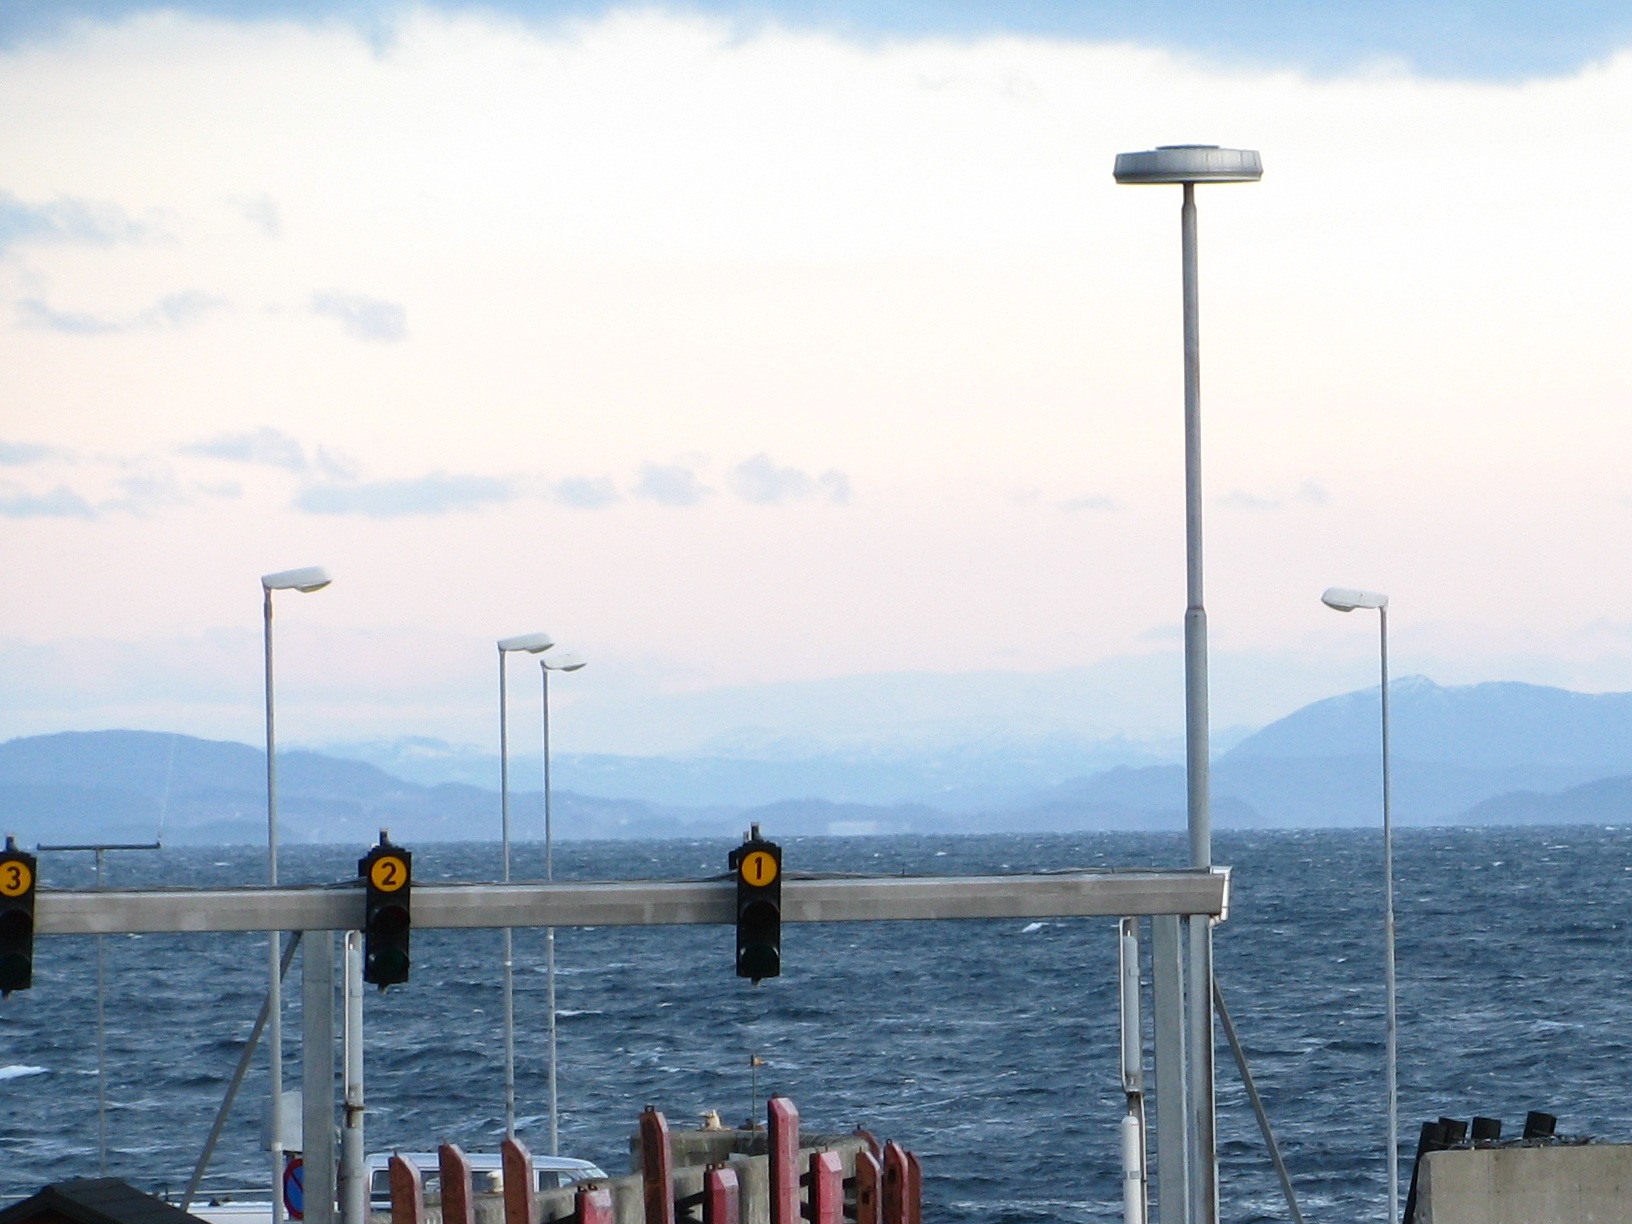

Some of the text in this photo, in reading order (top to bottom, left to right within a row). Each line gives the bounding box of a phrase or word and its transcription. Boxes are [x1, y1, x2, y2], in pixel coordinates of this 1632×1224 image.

[6, 866, 21, 890] 3
[381, 862, 397, 886] 2
[755, 856, 763, 880] 1
